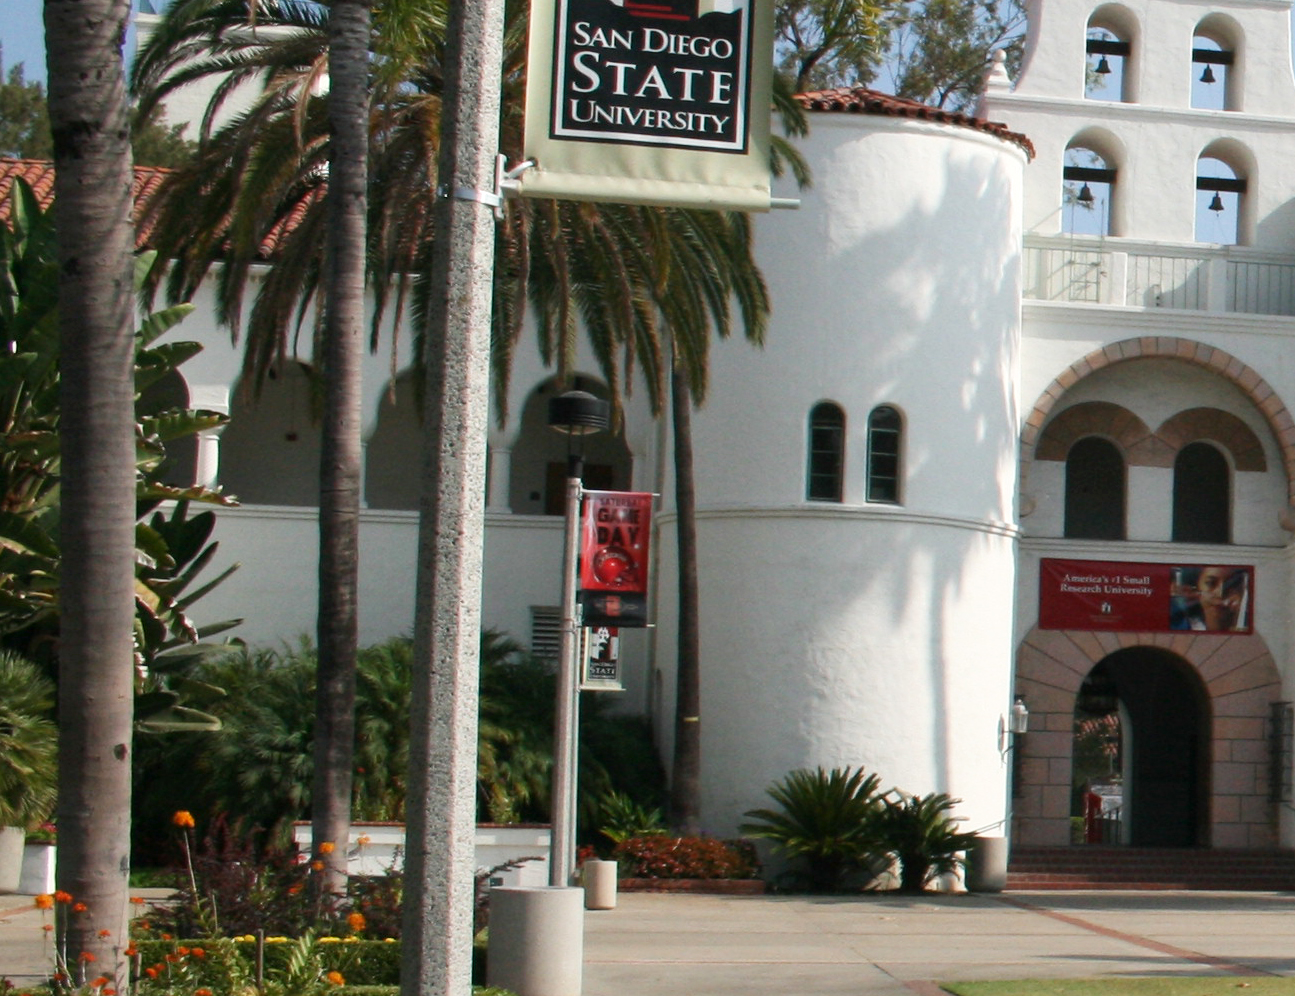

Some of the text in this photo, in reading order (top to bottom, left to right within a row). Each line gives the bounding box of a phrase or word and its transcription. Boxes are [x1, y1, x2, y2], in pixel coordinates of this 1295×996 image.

[574, 21, 733, 59] SAN DIEGO
[571, 51, 733, 105] STATE
[570, 98, 730, 134] UNIVERSITY
[597, 526, 639, 546] DAY
[1060, 583, 1153, 597] Research University
[1063, 573, 1109, 583] America's
[1123, 575, 1150, 585] Small
